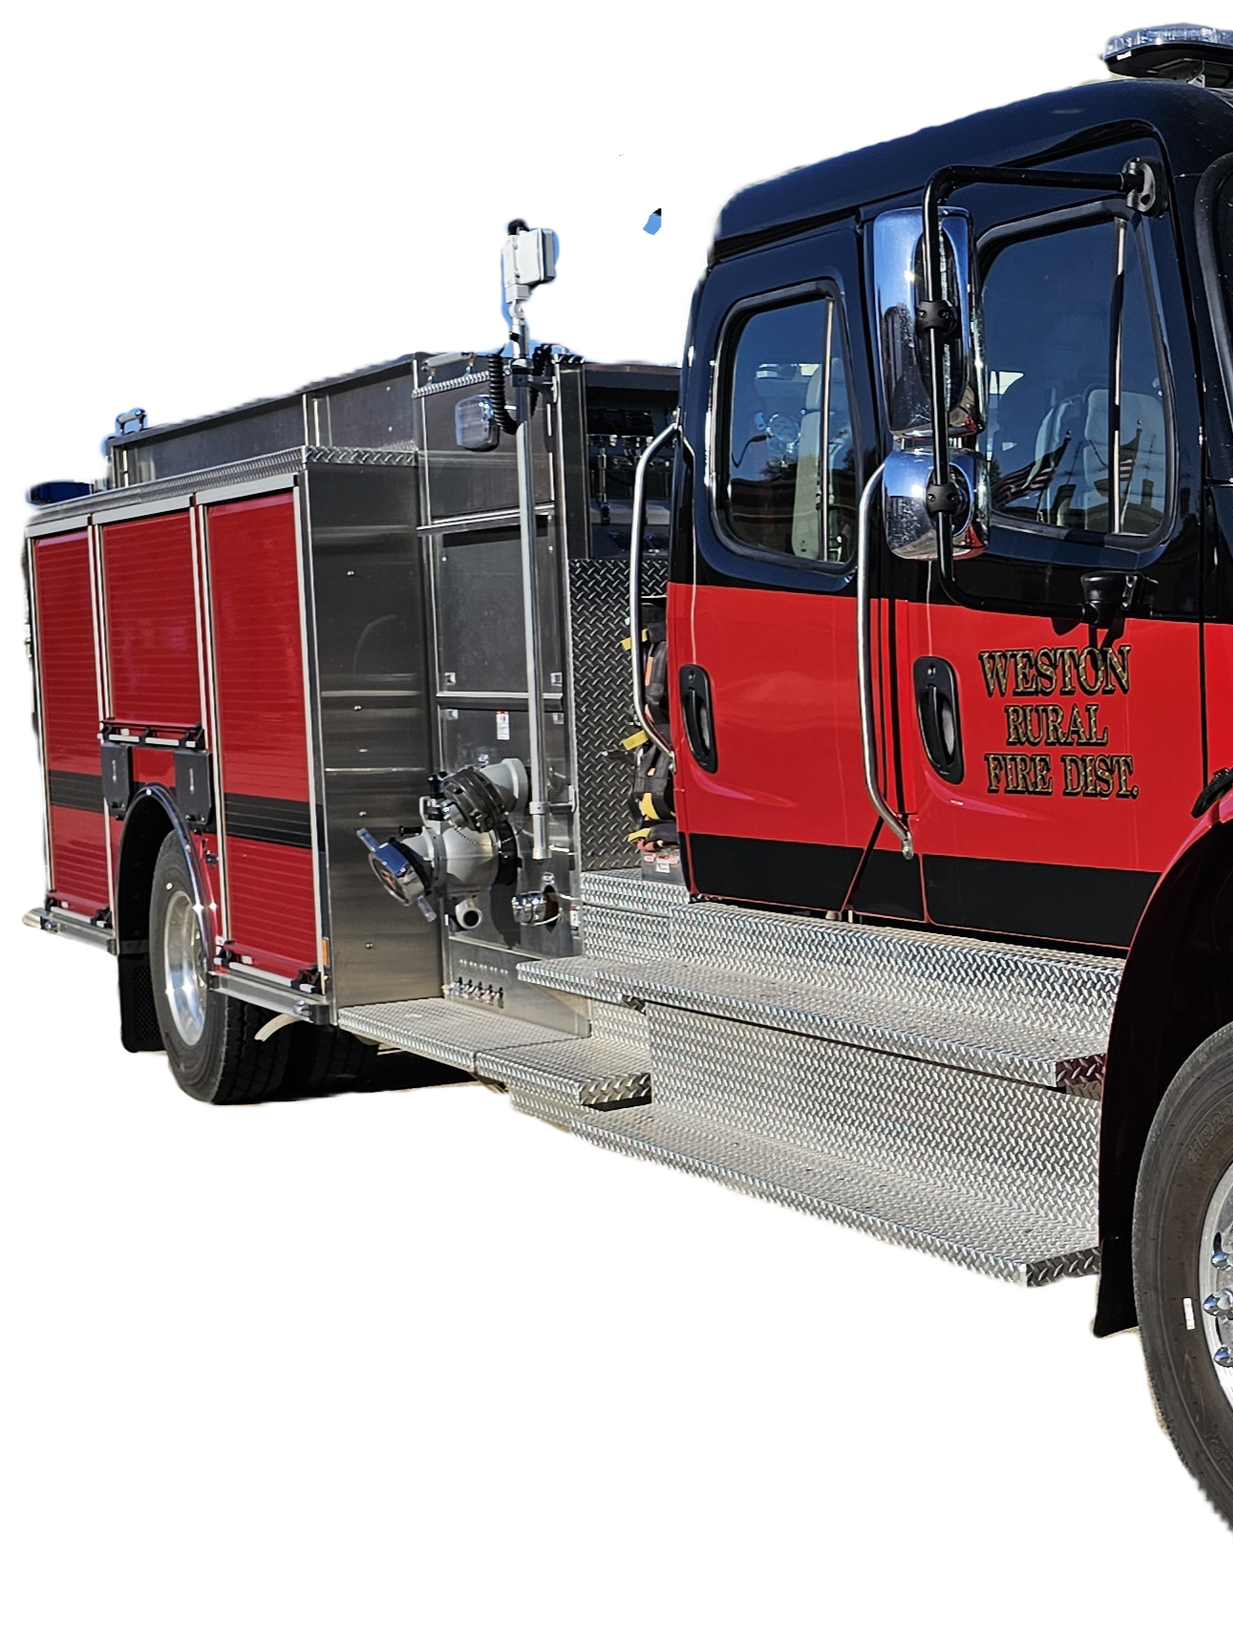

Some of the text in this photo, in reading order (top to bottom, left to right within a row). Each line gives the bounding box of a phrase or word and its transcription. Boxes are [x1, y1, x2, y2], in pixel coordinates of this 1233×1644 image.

[979, 645, 1131, 698] WESTON
[1005, 703, 1109, 747] RURAL
[984, 753, 1139, 799] FIRE DIST.
